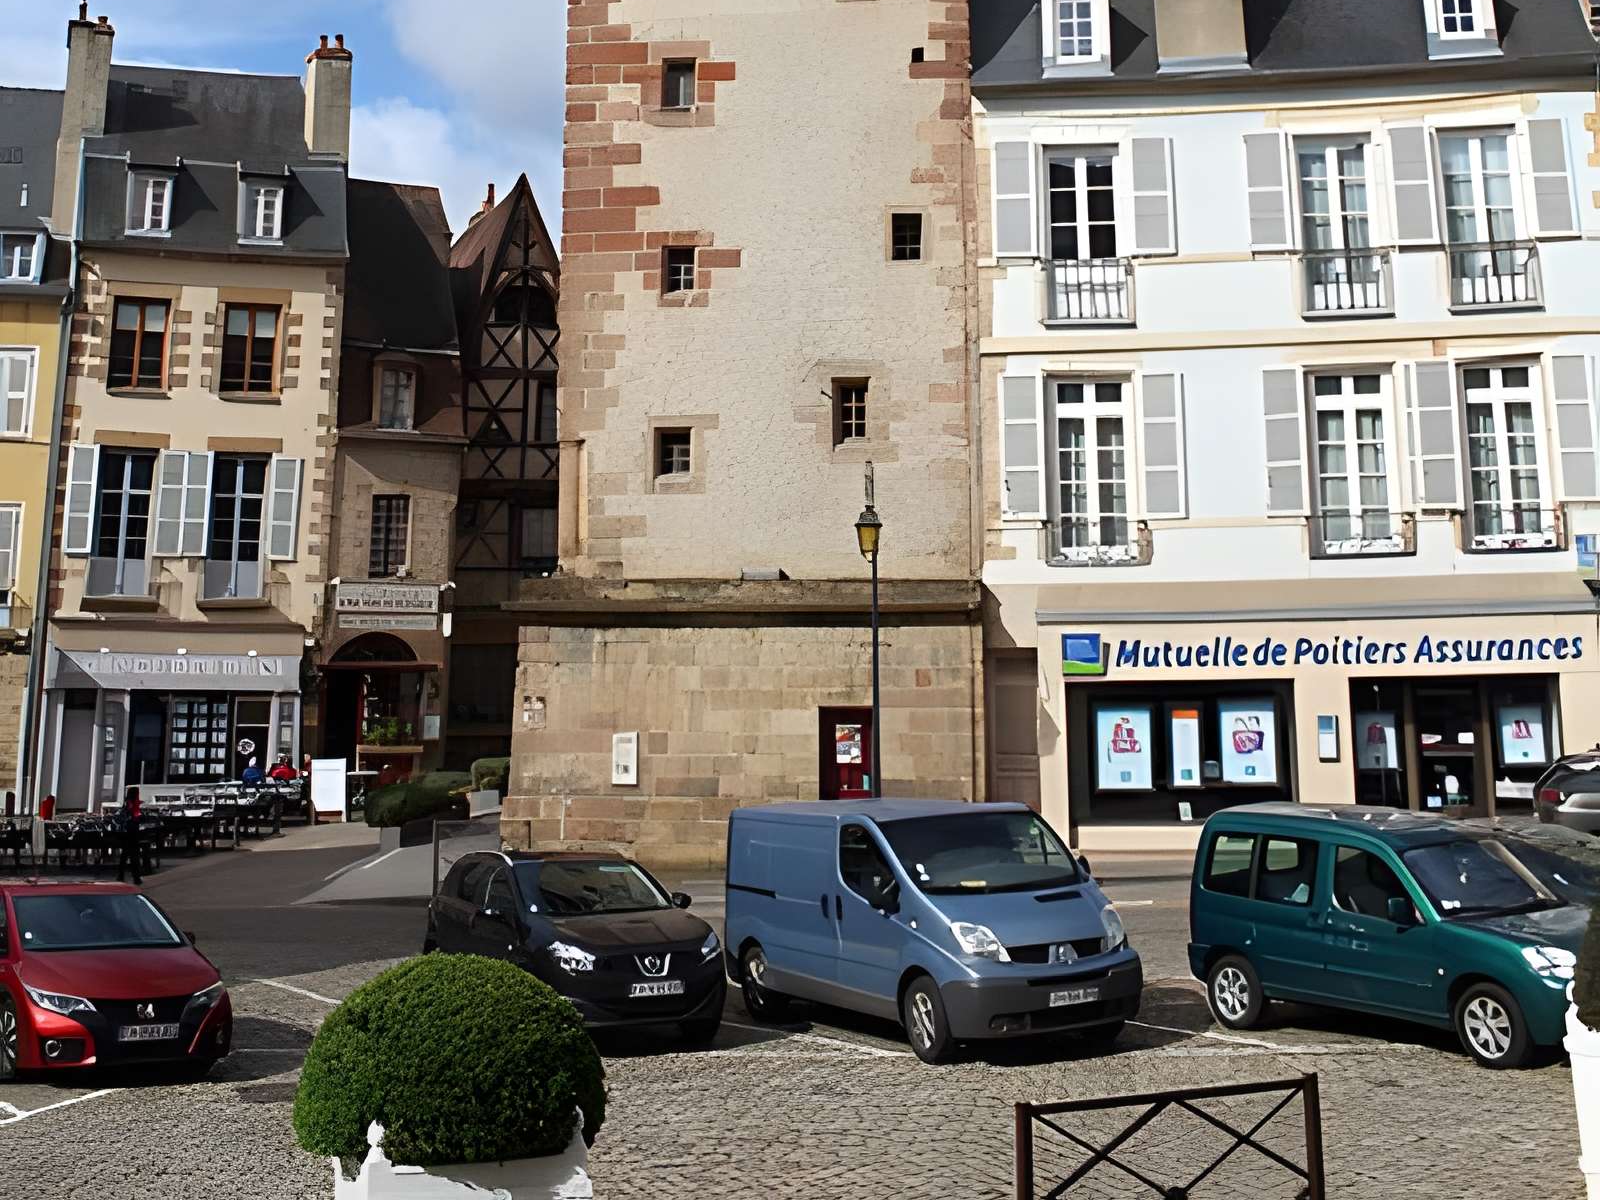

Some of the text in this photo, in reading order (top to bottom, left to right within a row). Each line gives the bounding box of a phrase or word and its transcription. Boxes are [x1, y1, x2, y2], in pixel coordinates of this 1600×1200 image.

[1115, 635, 1583, 668] Mutuelle de Poitiers Assurances
